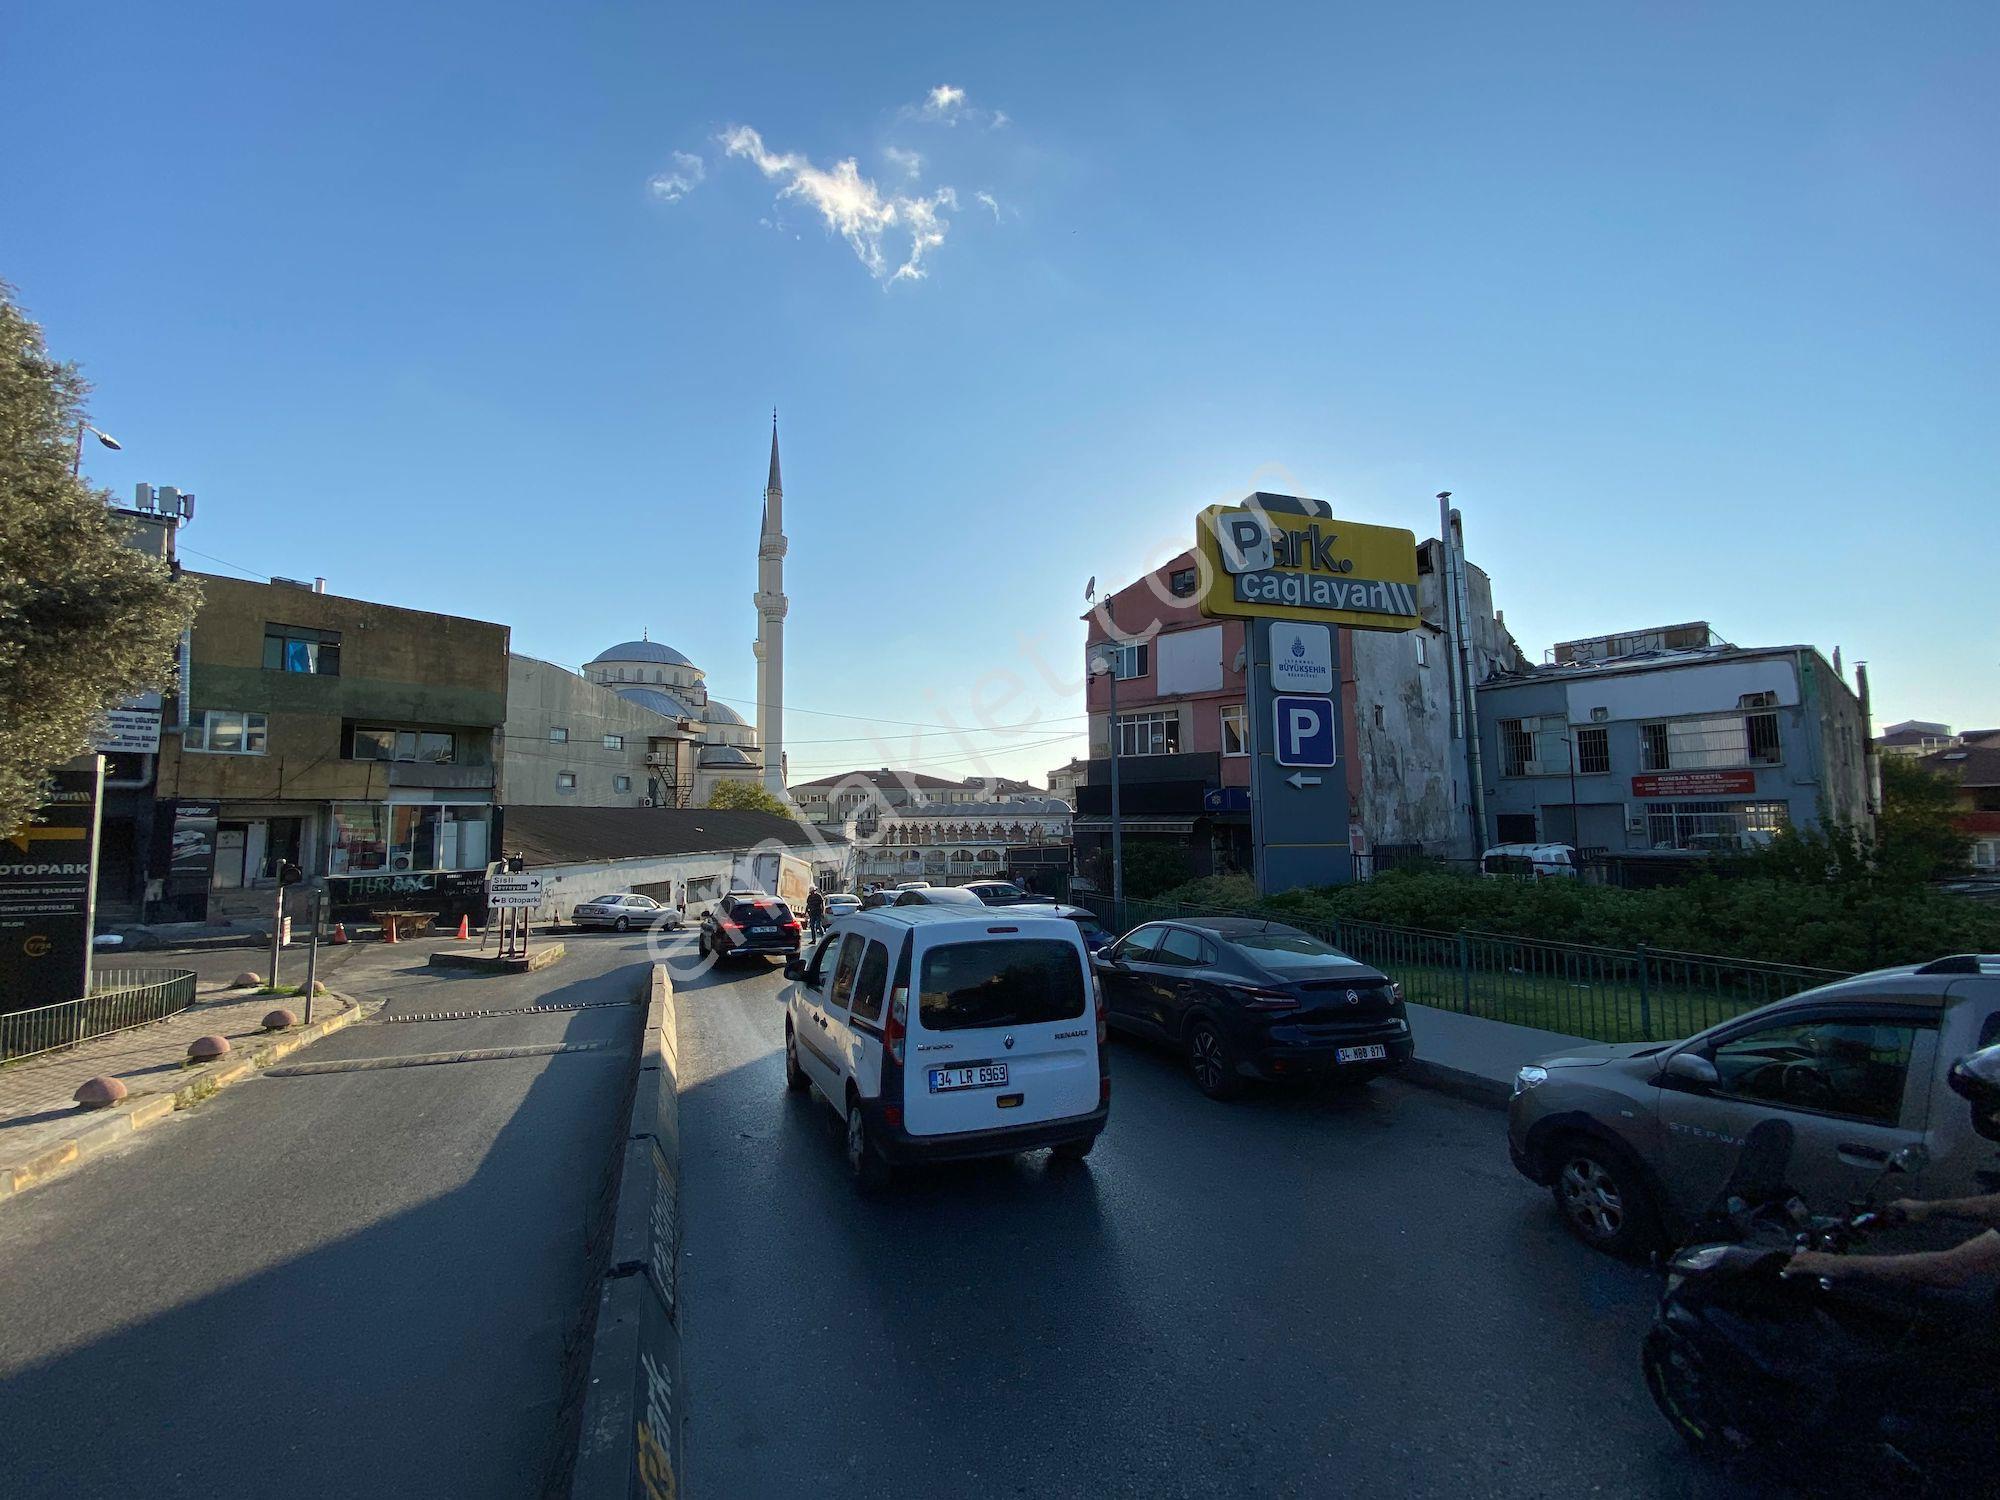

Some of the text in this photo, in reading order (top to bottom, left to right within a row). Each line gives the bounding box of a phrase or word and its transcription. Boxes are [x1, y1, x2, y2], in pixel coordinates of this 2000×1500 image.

[1289, 708, 1321, 755] P
[0, 863, 89, 876] OTOPARK
[1055, 1029, 1089, 1040] RENAULT
[1340, 1050, 1350, 1060] 34
[937, 1066, 1006, 1087] 34 LR 6969
